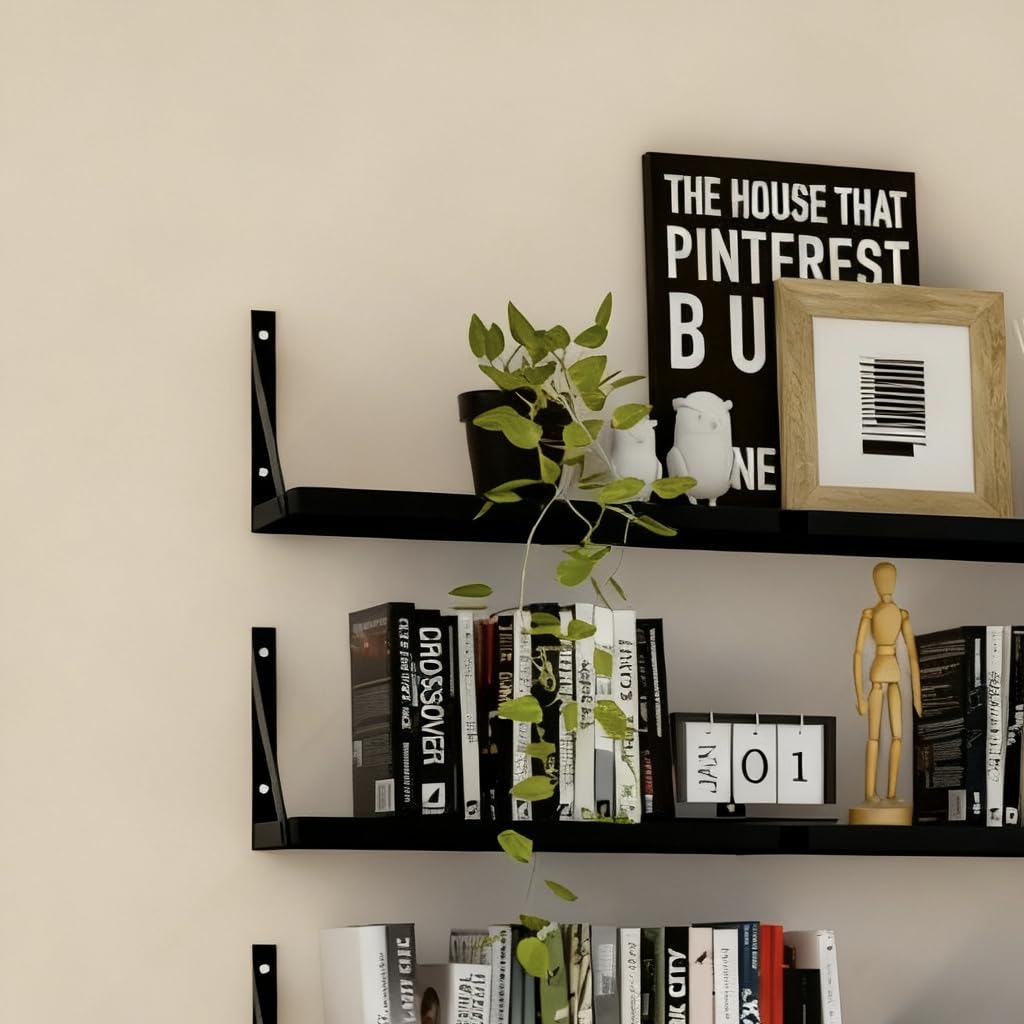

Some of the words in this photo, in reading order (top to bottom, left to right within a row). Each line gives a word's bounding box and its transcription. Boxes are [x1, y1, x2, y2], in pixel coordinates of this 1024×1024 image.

[664, 173, 722, 217] THE
[731, 178, 828, 224] HOUSE
[834, 186, 908, 229] THAT
[667, 225, 910, 286] PINTEREST
